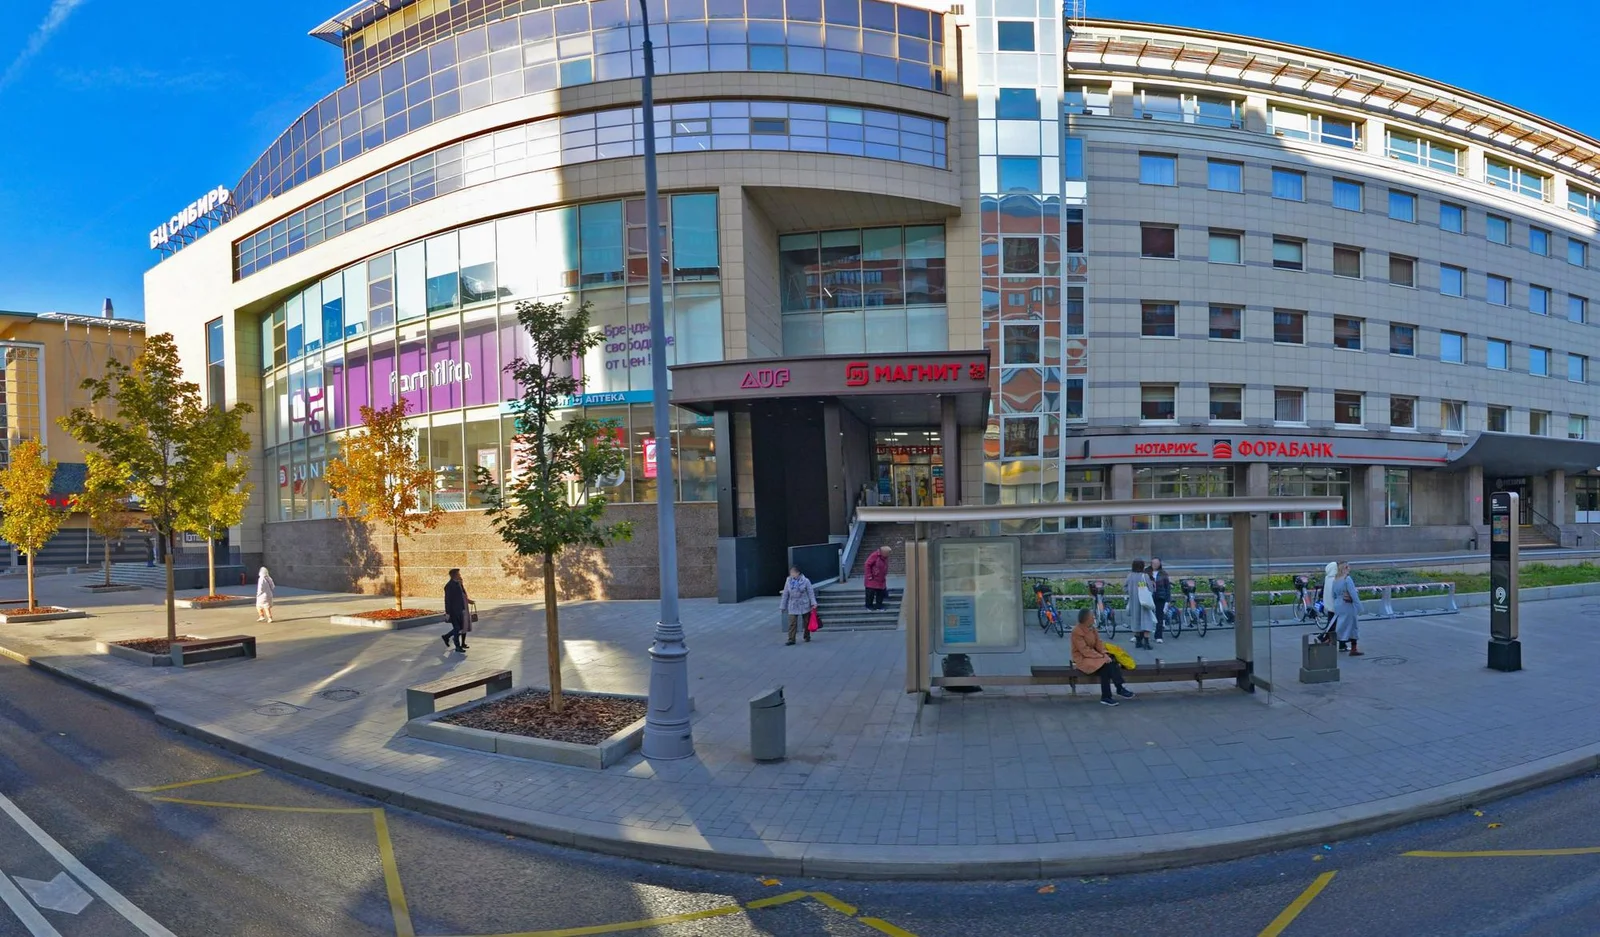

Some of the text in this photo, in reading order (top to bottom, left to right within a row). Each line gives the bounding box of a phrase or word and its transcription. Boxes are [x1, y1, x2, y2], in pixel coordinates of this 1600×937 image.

[150, 185, 230, 250] БЦ СИБИРЬ
[605, 336, 675, 354] свободе
[605, 359, 620, 370] от
[875, 363, 962, 383] МАГНИТ
[585, 393, 626, 404] АПТЕКА
[1134, 439, 1335, 458] НОТАРИУС ФОРАБАНК
